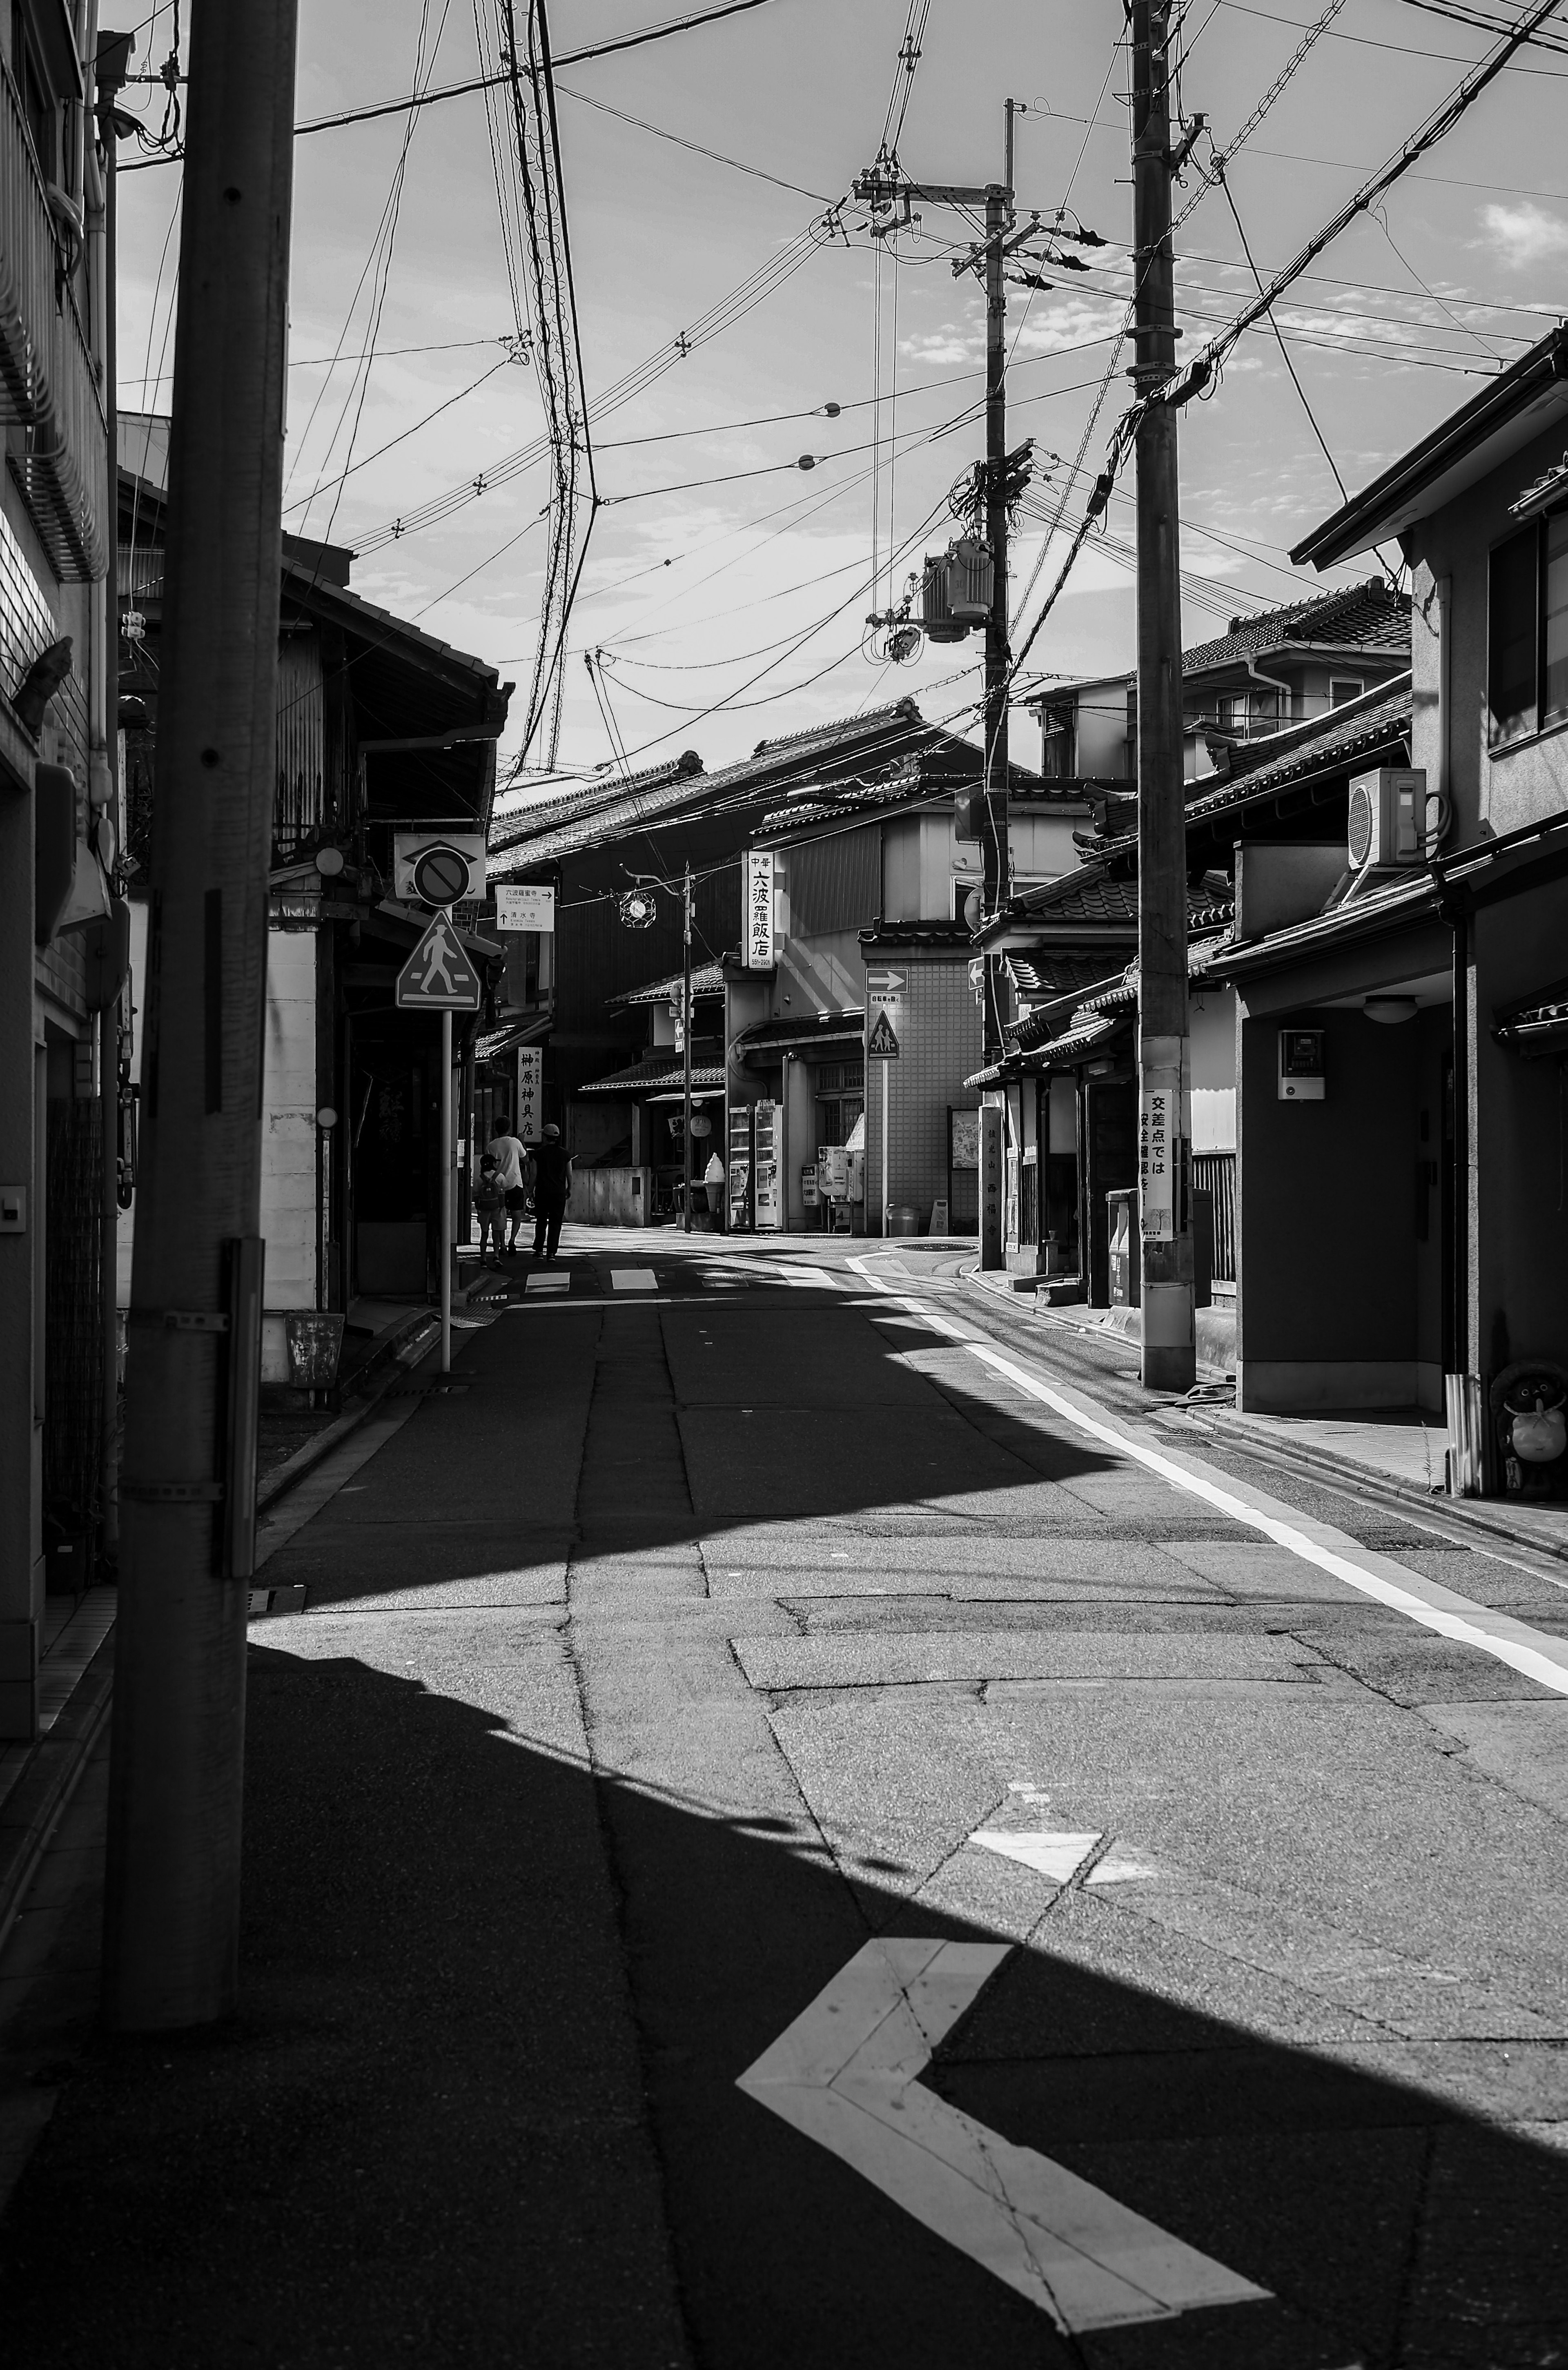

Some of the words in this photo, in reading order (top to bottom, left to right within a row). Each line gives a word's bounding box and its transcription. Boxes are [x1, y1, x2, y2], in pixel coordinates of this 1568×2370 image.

[751, 858, 771, 868] 中華
[753, 871, 770, 956] 六波羅飯店
[521, 1054, 535, 1136] 榊原神具店
[1152, 1096, 1165, 1174] 交差点では
